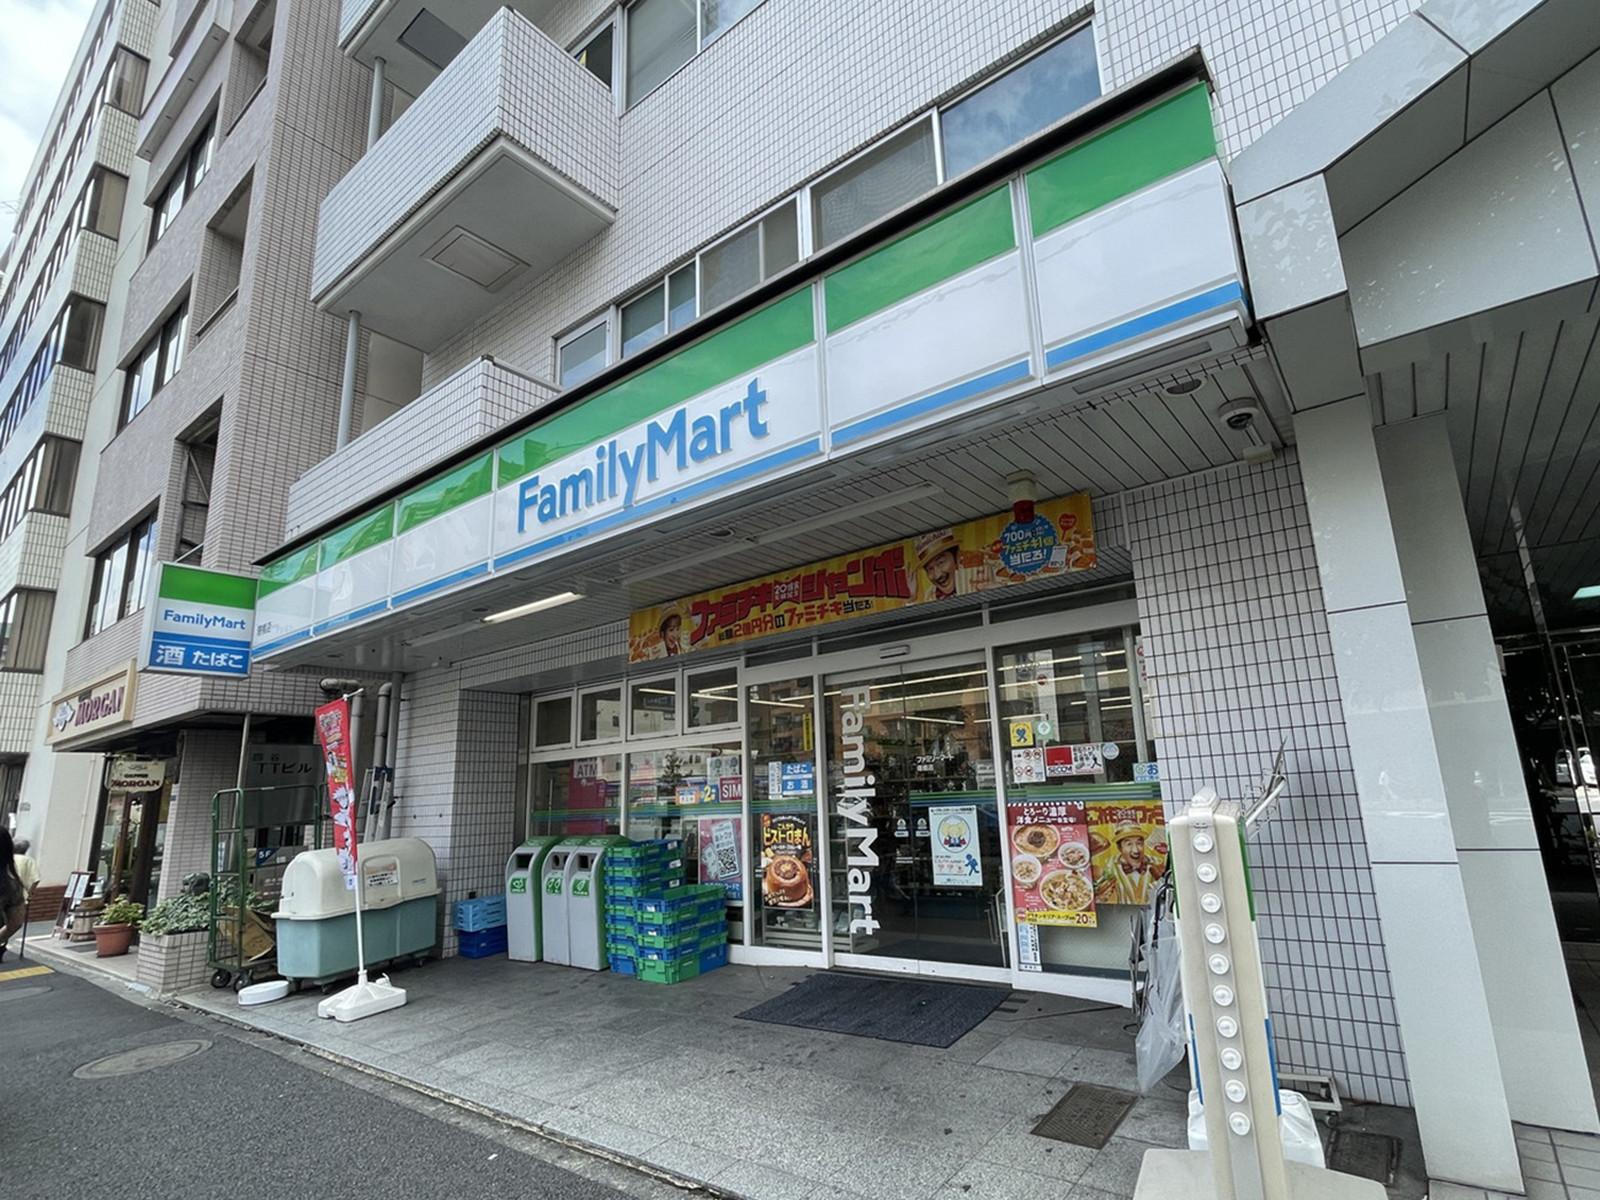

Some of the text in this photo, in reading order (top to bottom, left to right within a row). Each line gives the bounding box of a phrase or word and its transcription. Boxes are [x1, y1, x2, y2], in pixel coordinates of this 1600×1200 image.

[518, 376, 769, 534] FamilyMart
[689, 546, 912, 645] ファミチキ ジャンボ
[163, 609, 246, 630] FamilyMart
[155, 645, 244, 669] 酒 たばこ
[256, 761, 313, 775] TTビル
[786, 764, 808, 774] たばこ
[111, 779, 160, 788] MORGAN
[722, 783, 742, 799] SIM
[836, 684, 881, 936] FamilyMart
[763, 827, 811, 847] ビストロまん
[259, 850, 271, 859] 5F
